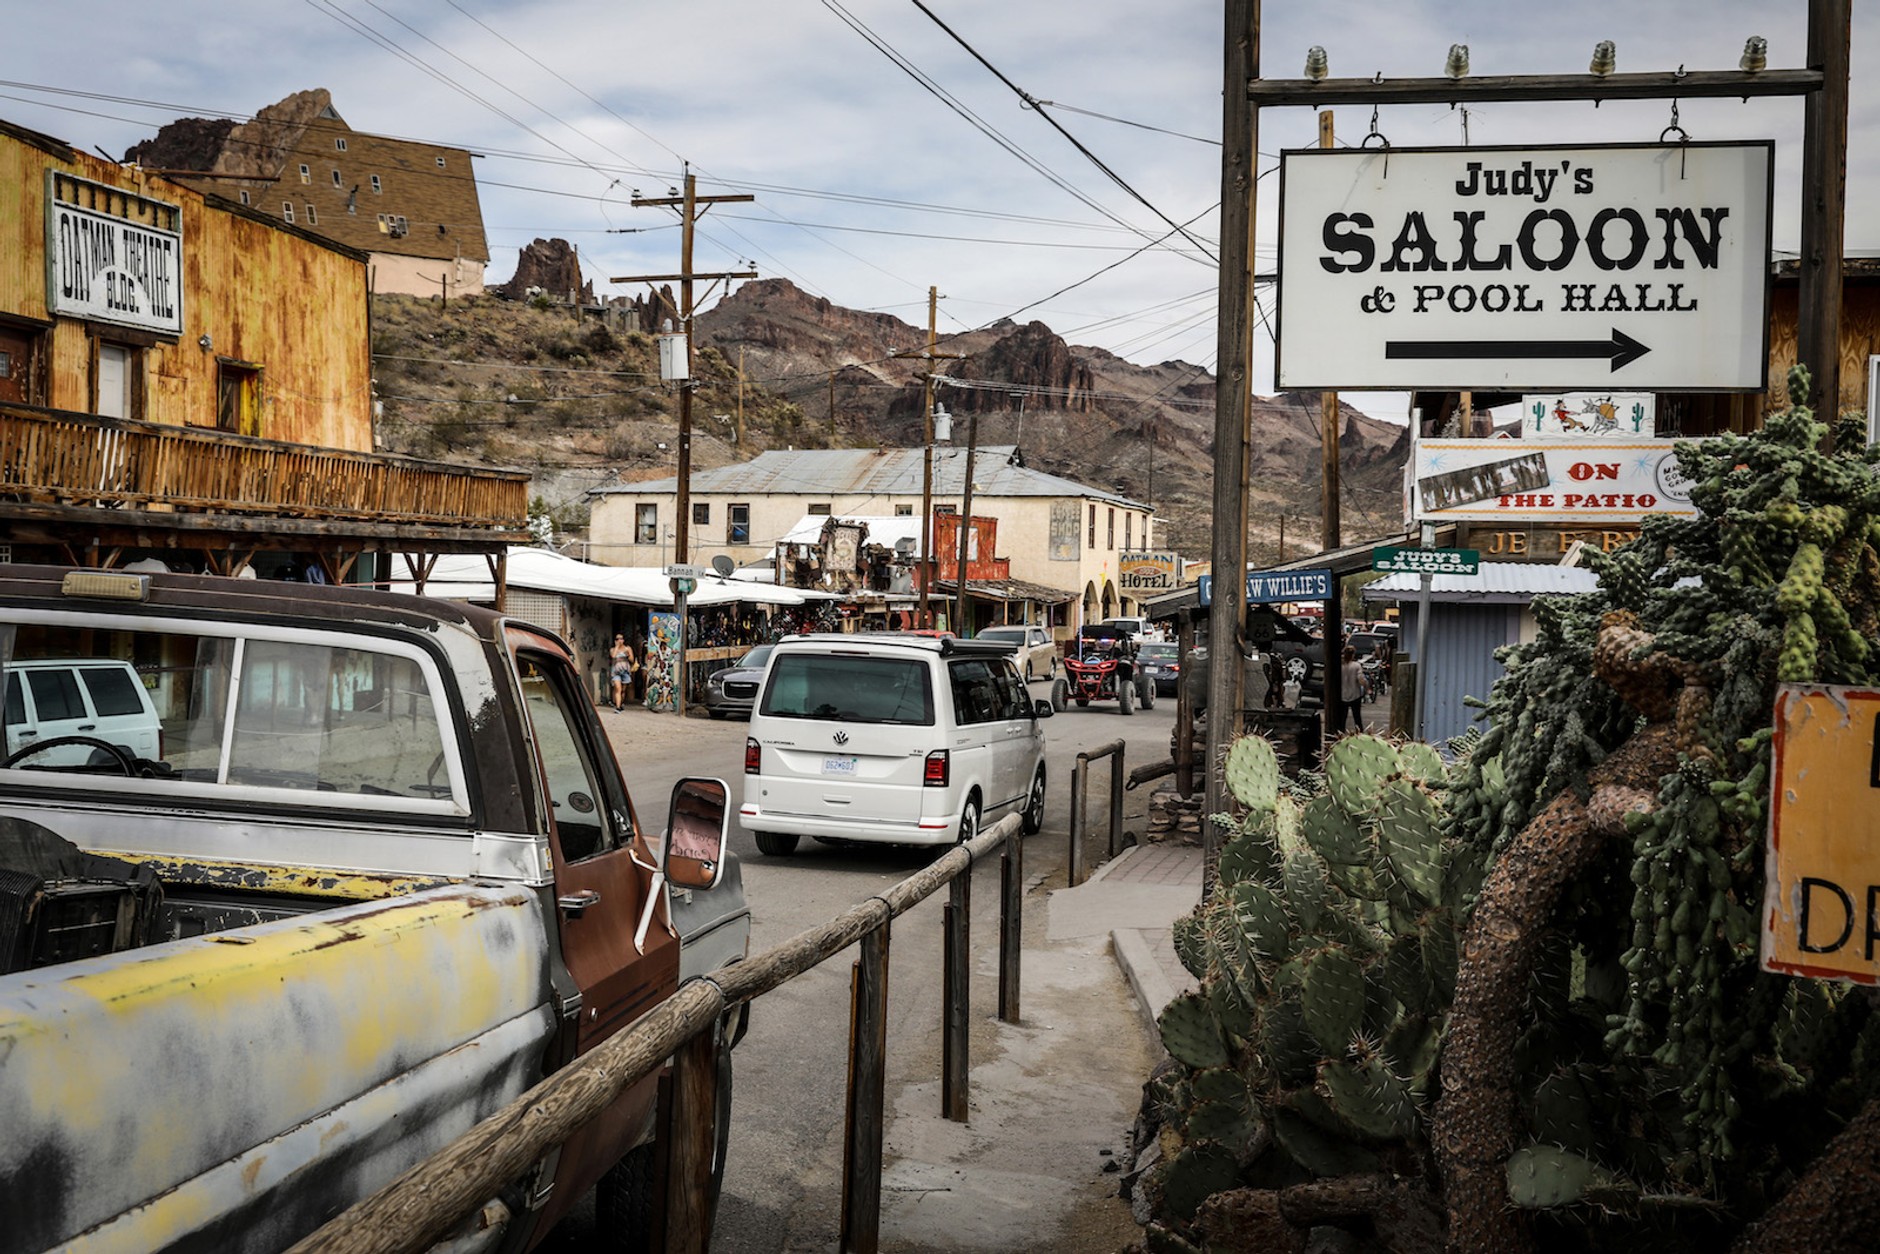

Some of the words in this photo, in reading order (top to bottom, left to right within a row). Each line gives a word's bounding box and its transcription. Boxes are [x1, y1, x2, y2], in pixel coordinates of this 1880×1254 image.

[1455, 161, 1594, 202] Judy's
[1319, 207, 1729, 274] SALOON
[61, 213, 115, 302] OATMAN
[123, 229, 173, 318] THEATRE
[106, 271, 140, 313] BLDG.
[1360, 285, 1396, 313] &
[1412, 284, 1543, 313] POOL
[1561, 283, 1698, 312] HALL
[1566, 461, 1622, 481] ON
[1498, 494, 1555, 508] THE
[1562, 493, 1658, 508] PATIO
[1376, 560, 1475, 573] SALOON
[1393, 551, 1461, 563] JUDY'S
[1120, 573, 1173, 588] HOTEL
[1266, 574, 1326, 597] WILLIE'S
